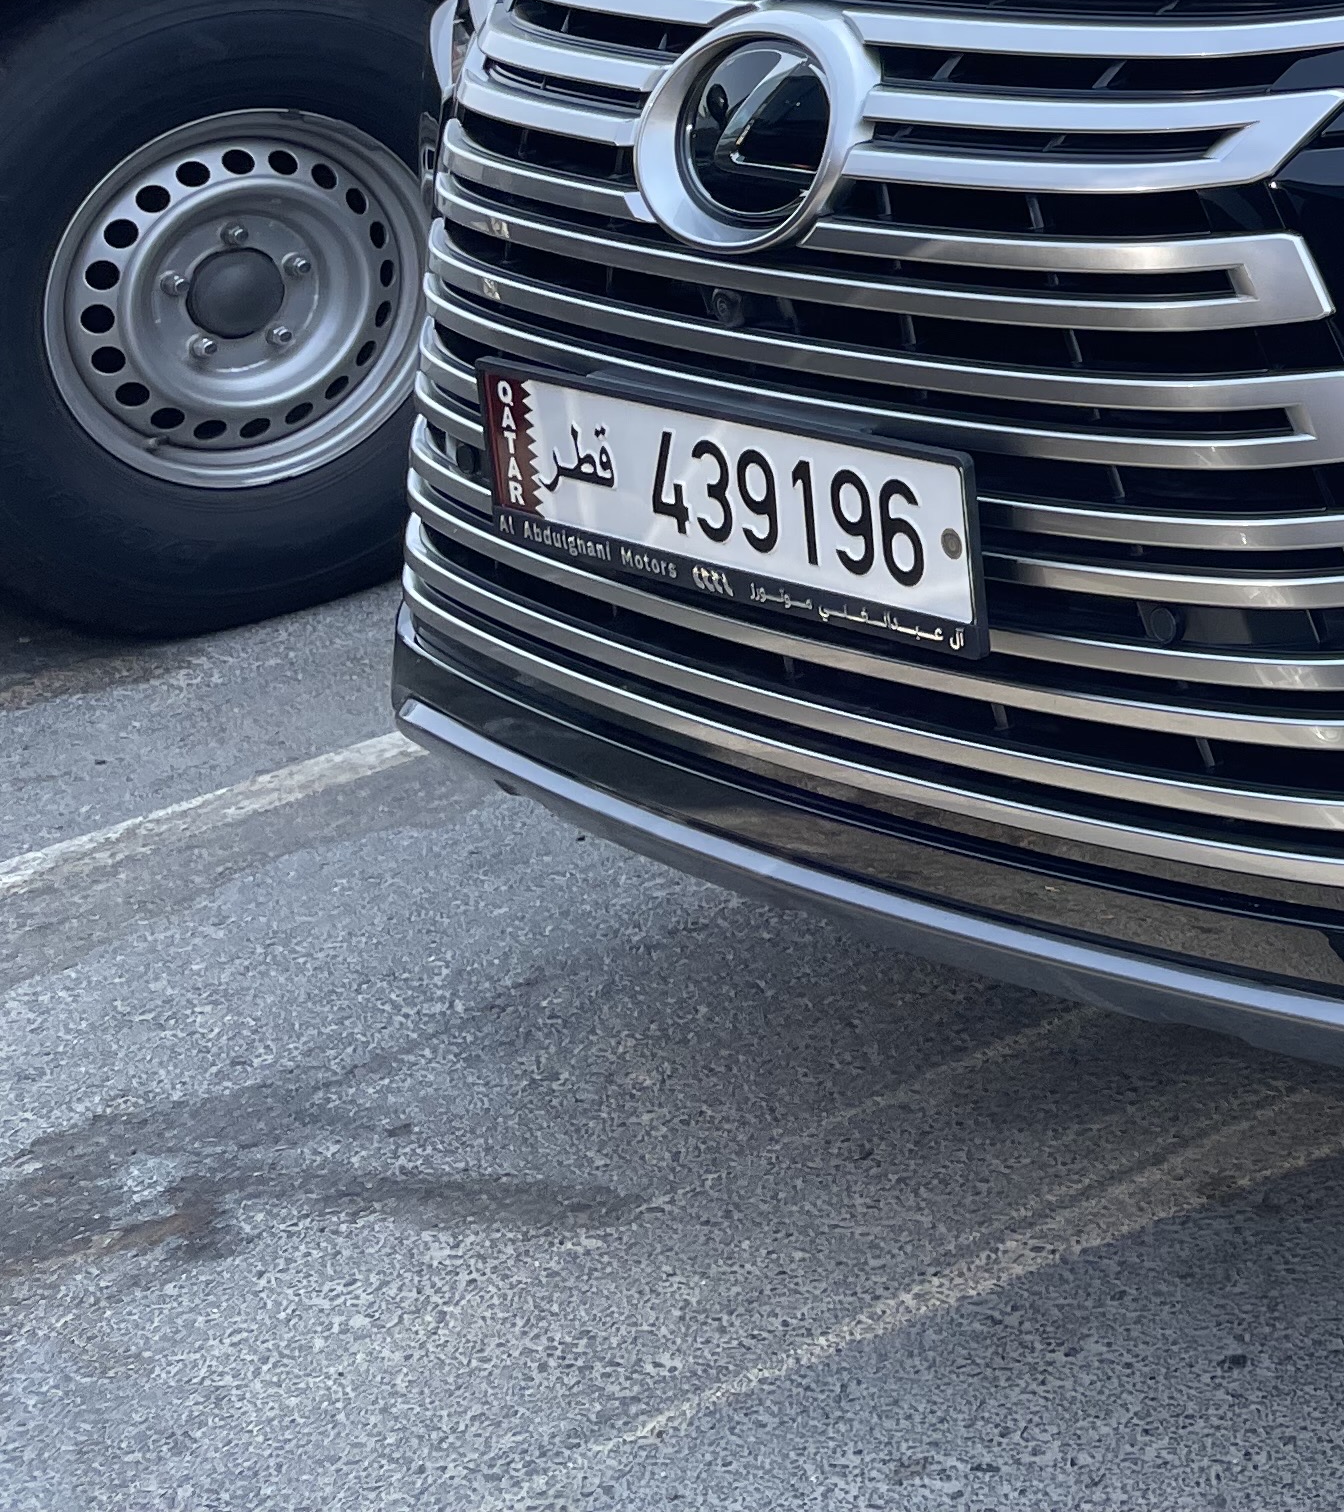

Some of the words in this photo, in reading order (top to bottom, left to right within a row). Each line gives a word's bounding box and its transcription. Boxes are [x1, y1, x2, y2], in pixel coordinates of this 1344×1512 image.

[497, 379, 526, 507] QATAR
[543, 422, 617, 492] قطر
[500, 514, 516, 536] Al
[620, 545, 678, 579] Motors
[652, 430, 926, 587] 439196
